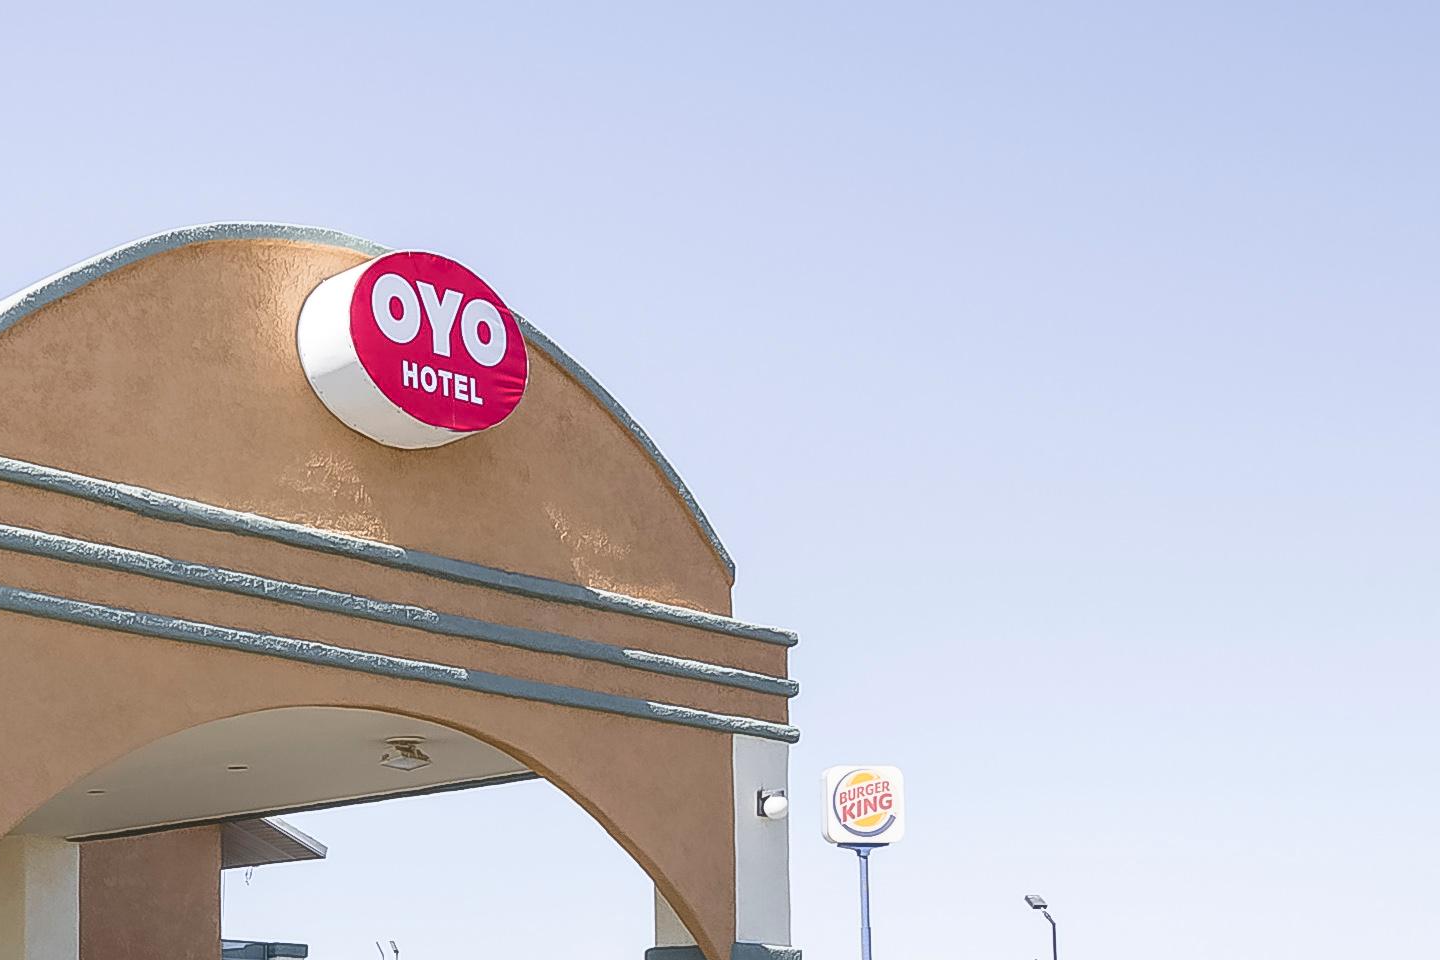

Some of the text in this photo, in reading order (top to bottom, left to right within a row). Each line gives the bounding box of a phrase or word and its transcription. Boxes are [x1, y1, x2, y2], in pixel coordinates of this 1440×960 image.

[372, 273, 507, 367] OYO
[402, 360, 483, 405] HOTEL
[840, 781, 890, 805] BURGER
[842, 793, 892, 822] KING
